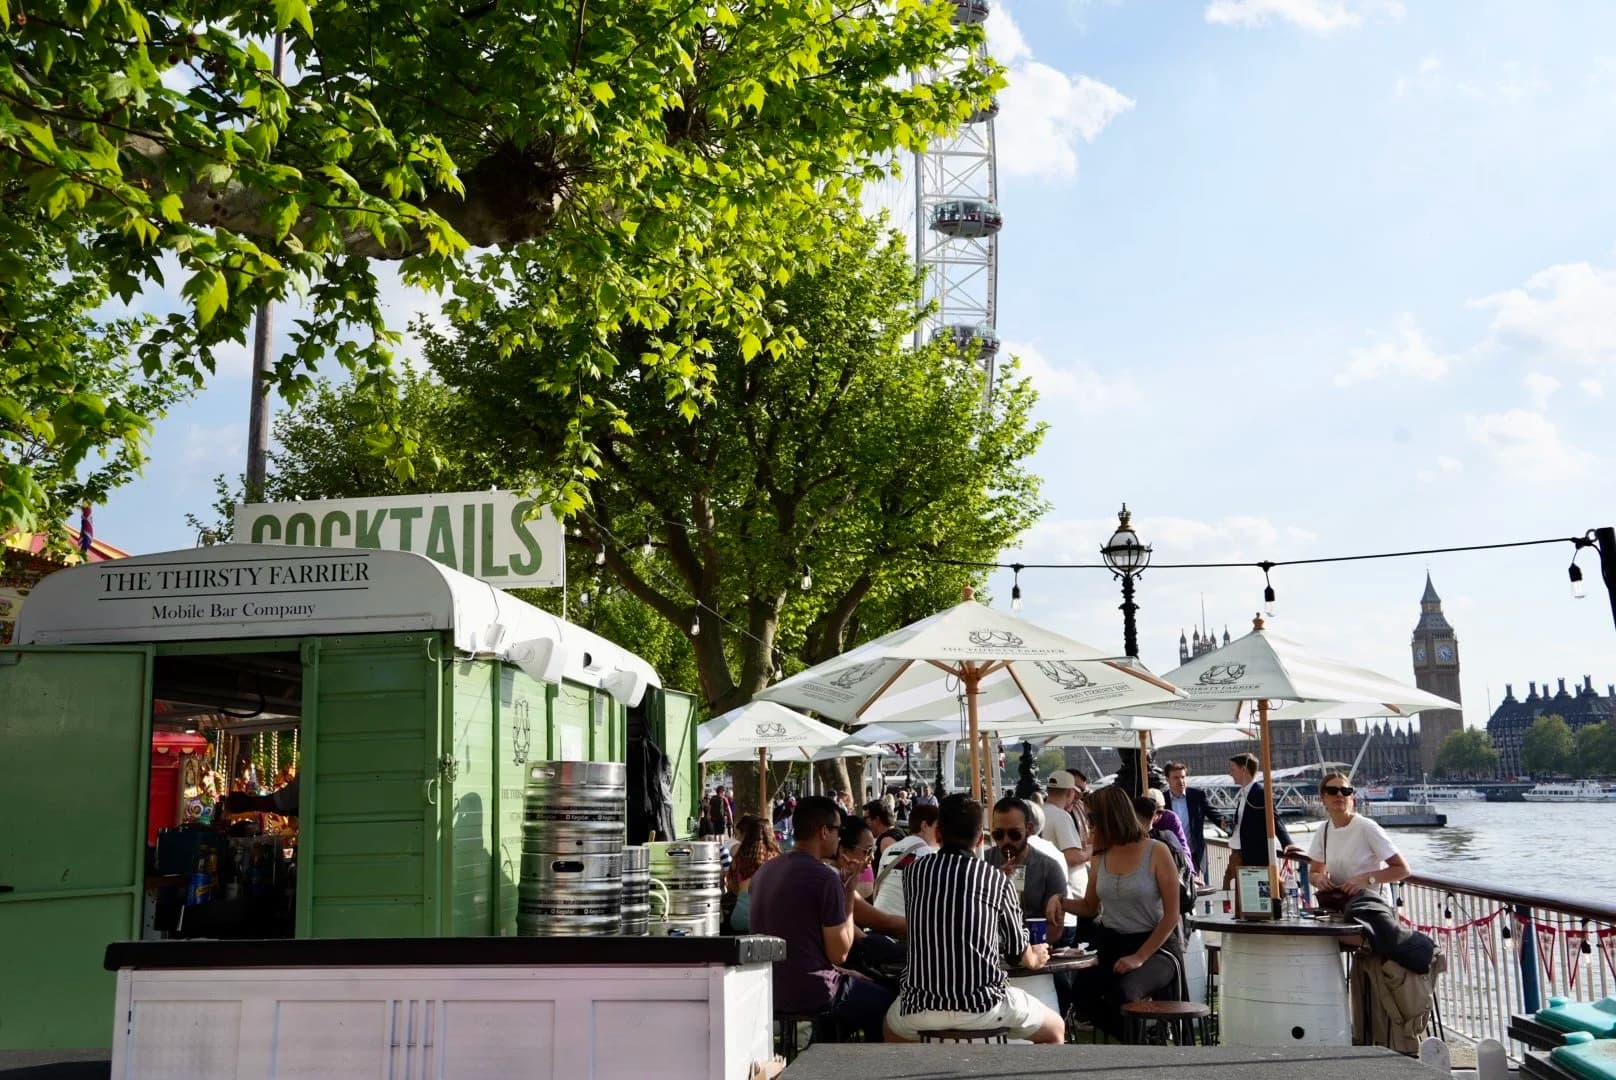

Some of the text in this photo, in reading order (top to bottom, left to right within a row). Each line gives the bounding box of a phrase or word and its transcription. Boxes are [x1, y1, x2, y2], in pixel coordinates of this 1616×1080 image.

[101, 562, 370, 592] THE THIRSTY FARRIER
[151, 602, 316, 620] Mobile Bar Company
